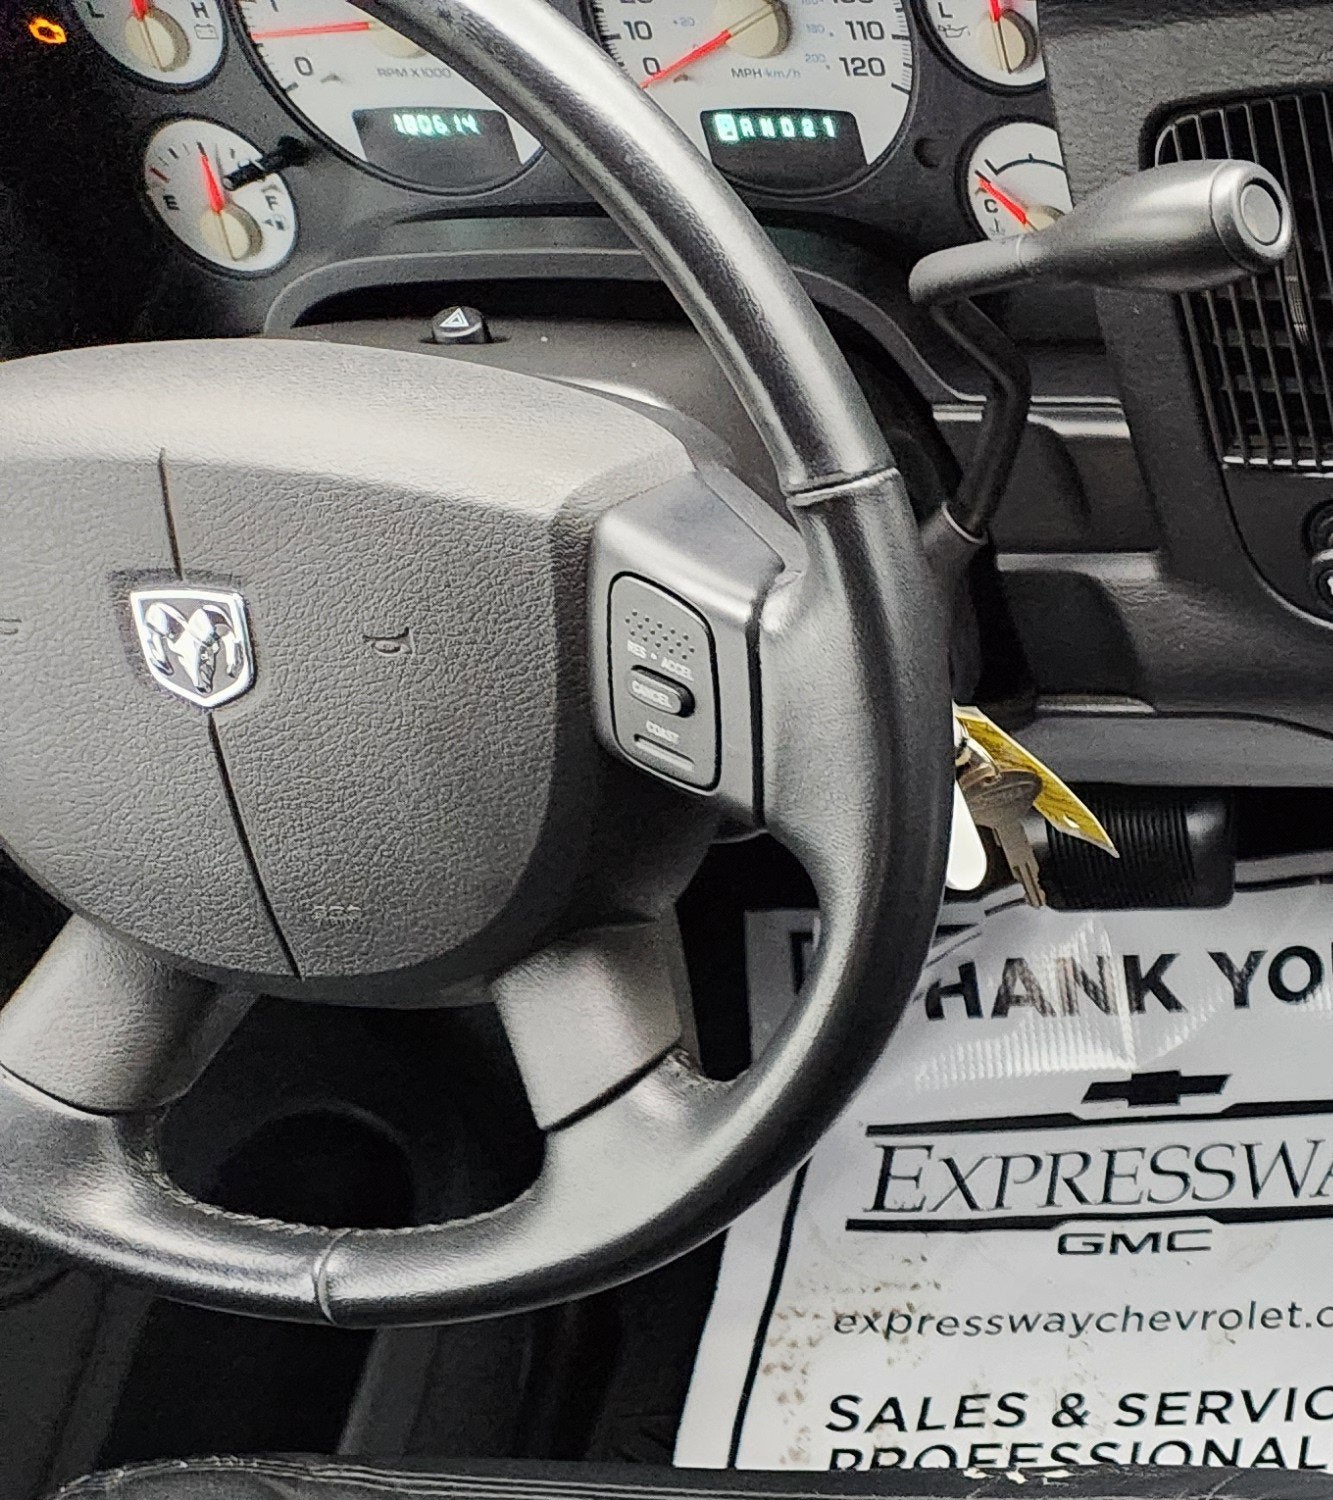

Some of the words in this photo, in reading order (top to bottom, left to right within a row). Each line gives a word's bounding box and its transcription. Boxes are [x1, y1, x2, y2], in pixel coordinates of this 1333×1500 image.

[938, 2, 954, 18] L
[623, 20, 653, 41] 10
[844, 20, 885, 41] 110
[294, 56, 313, 76] 0
[376, 67, 407, 78] RPM
[642, 57, 661, 76] 0
[731, 67, 763, 79] MPH
[838, 57, 886, 77] 120
[984, 199, 999, 214] C
[924, 953, 1182, 1021] HANK
[1056, 1227, 1214, 1257] GMC
[825, 1392, 1028, 1433] SALES
[1051, 1391, 1089, 1429] &
